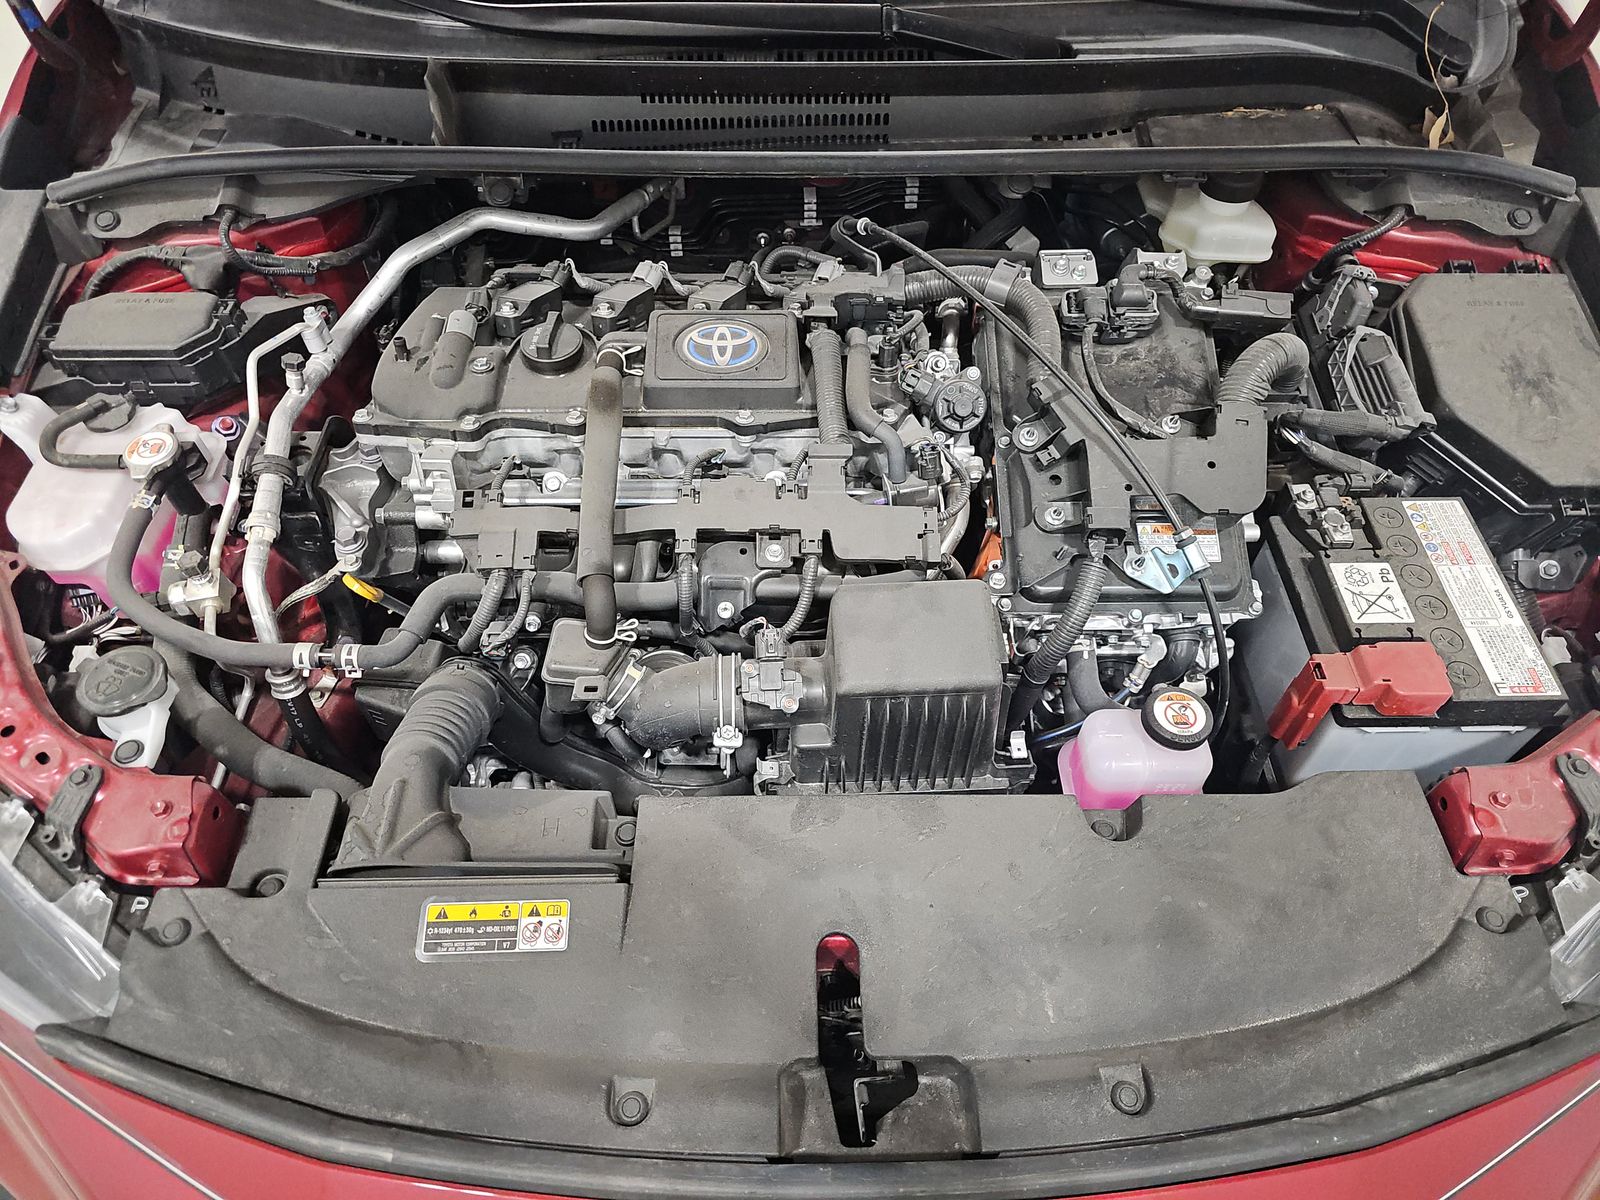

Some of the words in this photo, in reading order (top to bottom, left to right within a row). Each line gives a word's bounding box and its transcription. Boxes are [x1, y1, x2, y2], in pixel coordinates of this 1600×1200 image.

[1380, 568, 1394, 583] Pb
[1495, 589, 1510, 609] YUASA
[130, 897, 149, 913] P
